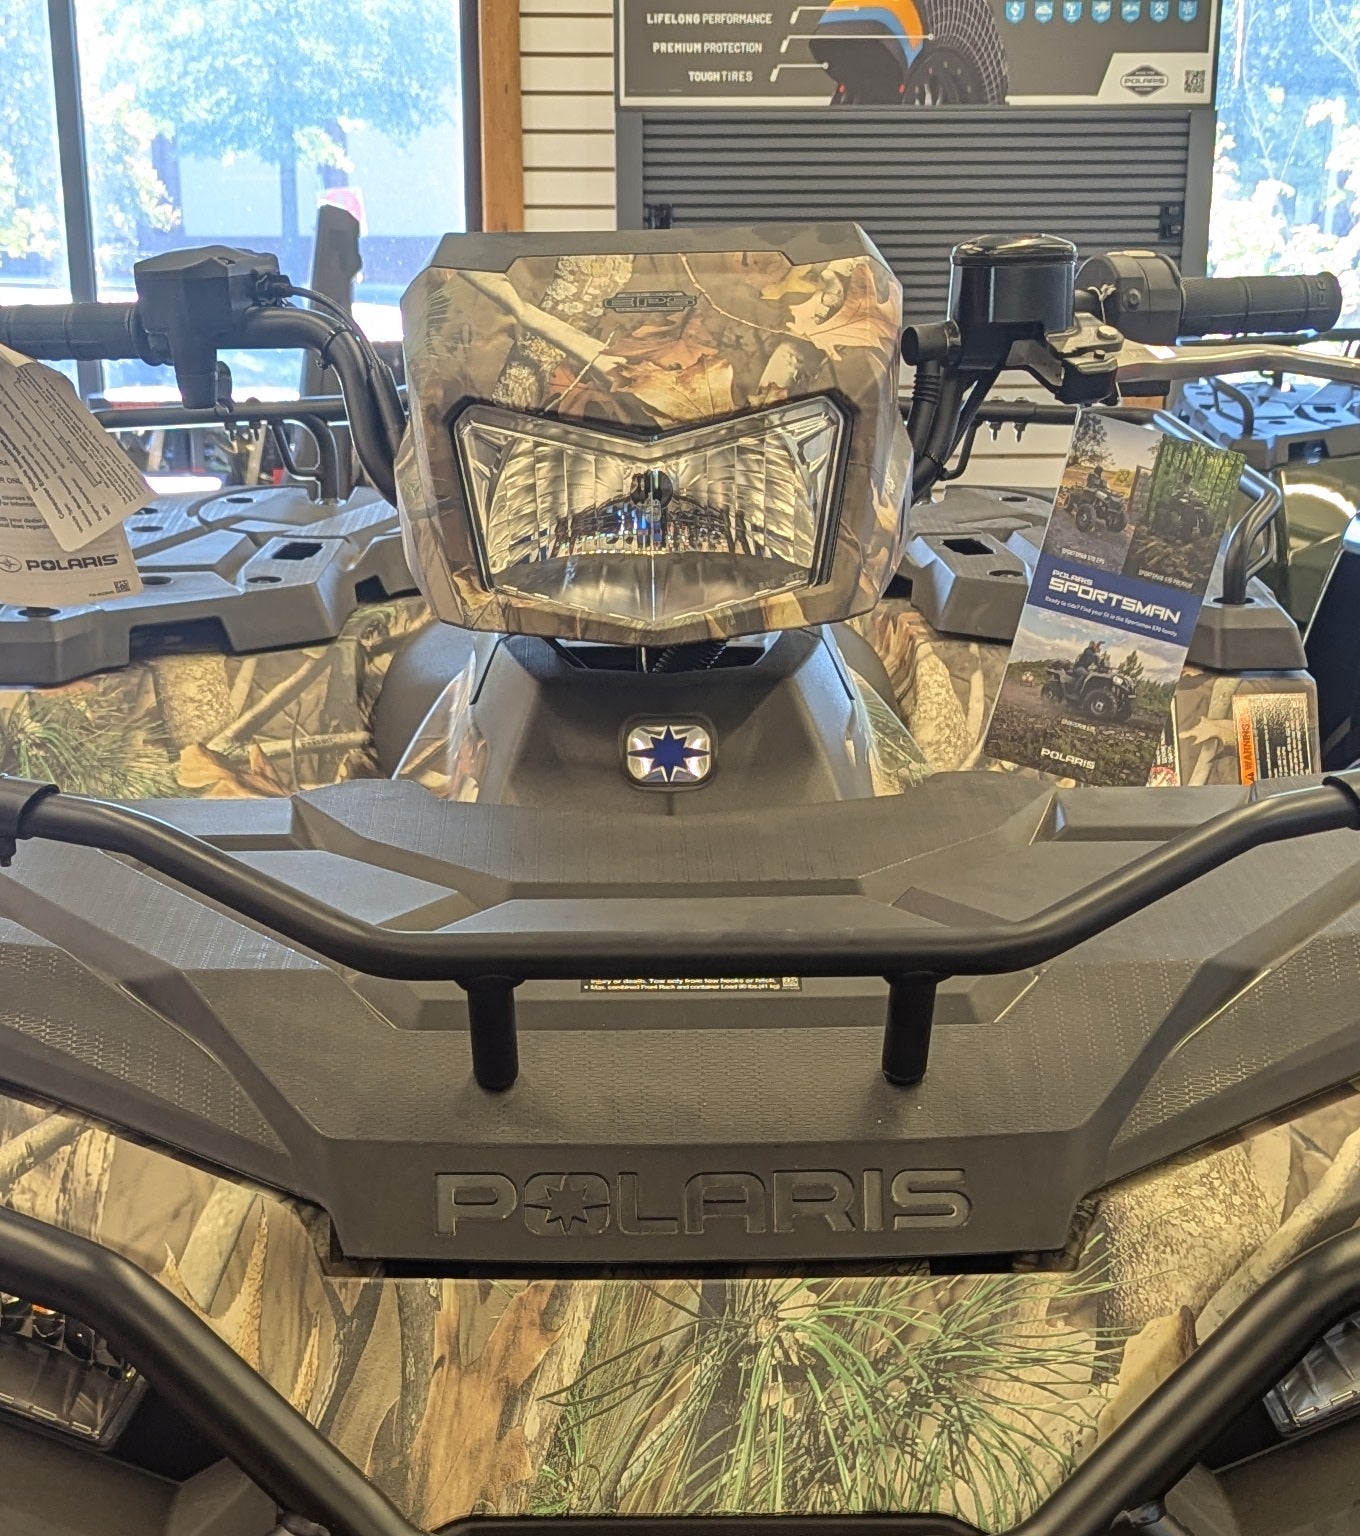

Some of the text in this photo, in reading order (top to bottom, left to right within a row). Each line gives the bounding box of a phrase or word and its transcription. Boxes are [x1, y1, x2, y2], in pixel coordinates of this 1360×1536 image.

[646, 13, 773, 25] LIFELONG PERFORMANCE
[652, 42, 763, 54] PREMIUM PROTECTION
[688, 70, 754, 82] TOUGH TIRES
[25, 555, 118, 572] POLARIS
[1051, 569, 1094, 586] POLARIS
[1048, 577, 1182, 625] SPORTSMAN
[1040, 747, 1096, 770] POLARIS
[433, 1167, 973, 1236] POLARIS
